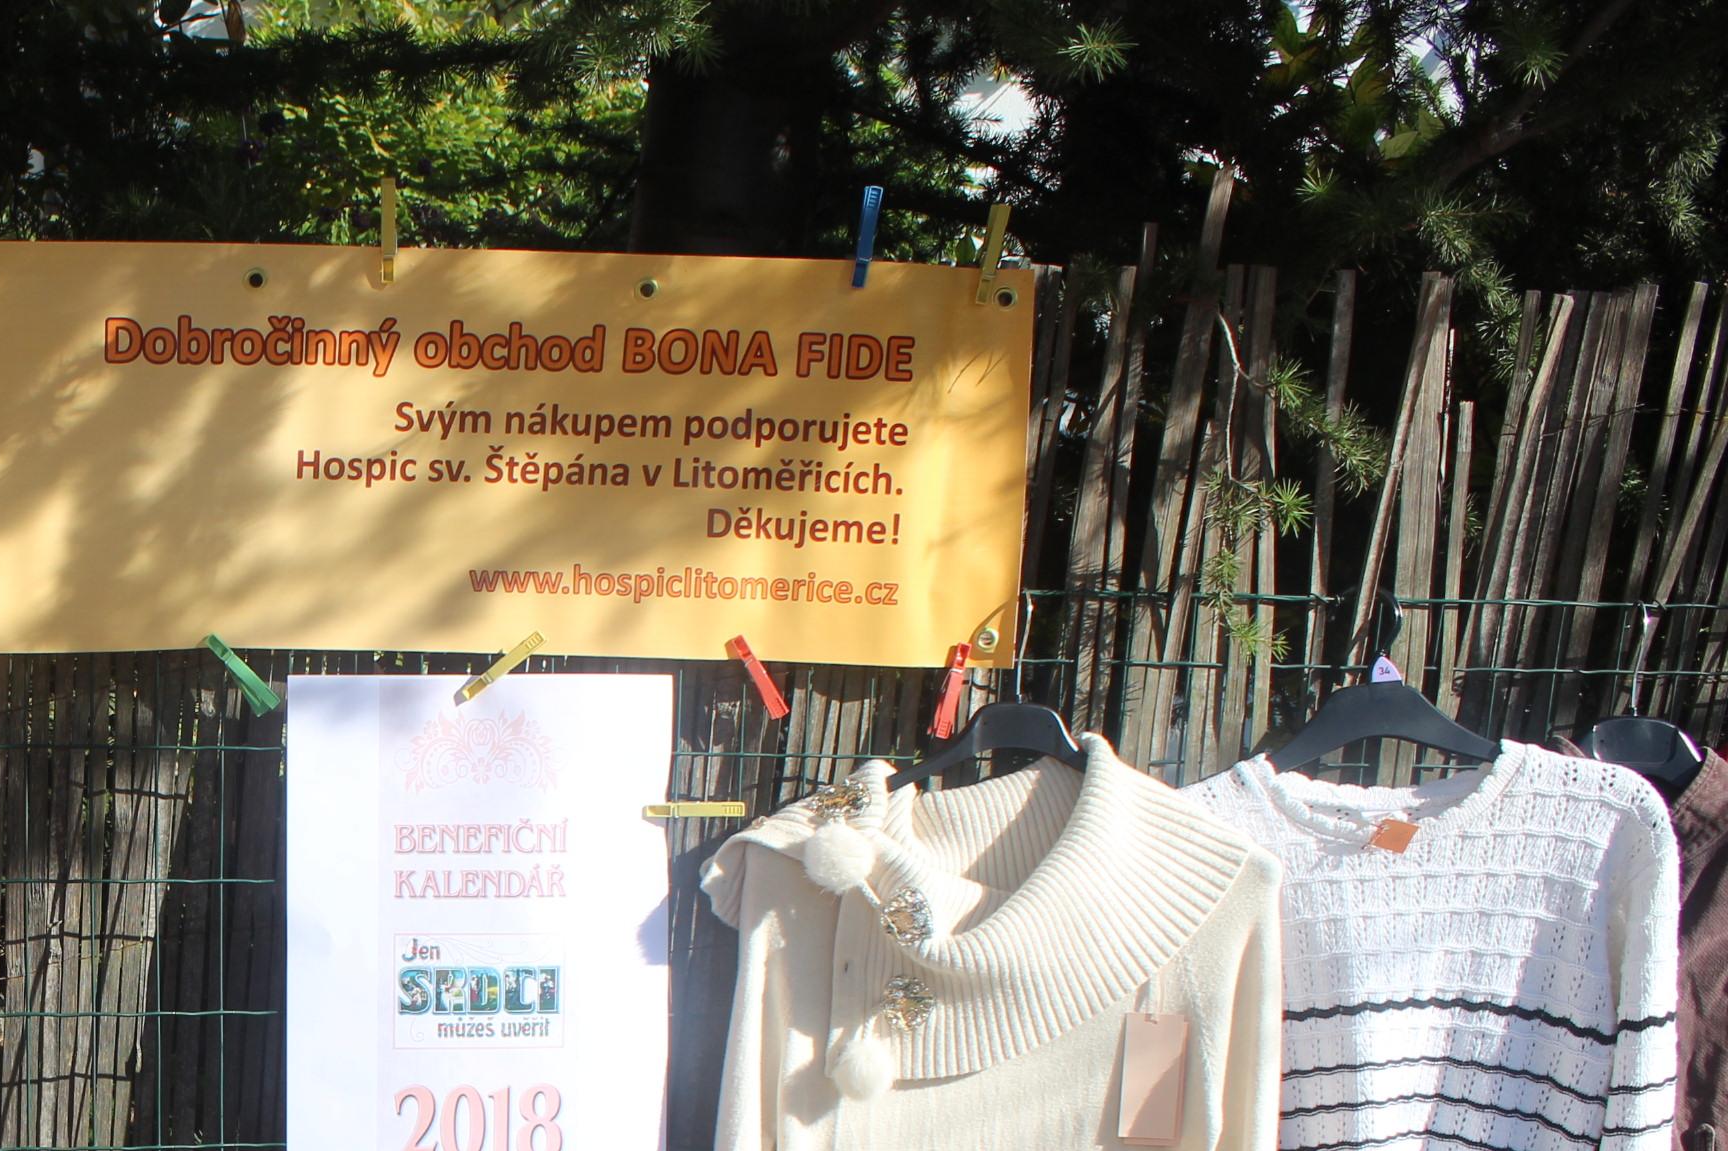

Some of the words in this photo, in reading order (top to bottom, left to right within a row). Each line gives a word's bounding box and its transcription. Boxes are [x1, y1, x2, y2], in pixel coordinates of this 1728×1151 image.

[105, 315, 400, 377] Dobročinný
[414, 319, 607, 374] obchod
[622, 327, 778, 377] BONA
[796, 332, 916, 382] FIDE
[394, 401, 491, 440] Svým
[505, 402, 672, 444] nákupem
[683, 408, 909, 451] podporujete
[296, 449, 417, 487] Hospic
[428, 456, 471, 483] sv.
[483, 445, 630, 492] Štěpána
[642, 462, 663, 487] v
[673, 457, 904, 496] Litoměřicích.
[706, 507, 901, 549] Děkujeme!
[469, 563, 900, 606] www.hospiclitomerice.cz
[394, 818, 568, 854] BENEFIČNÍ
[394, 863, 567, 898] KALENDÁŘ
[402, 938, 441, 962] Jen
[398, 965, 561, 1015] SRDCI
